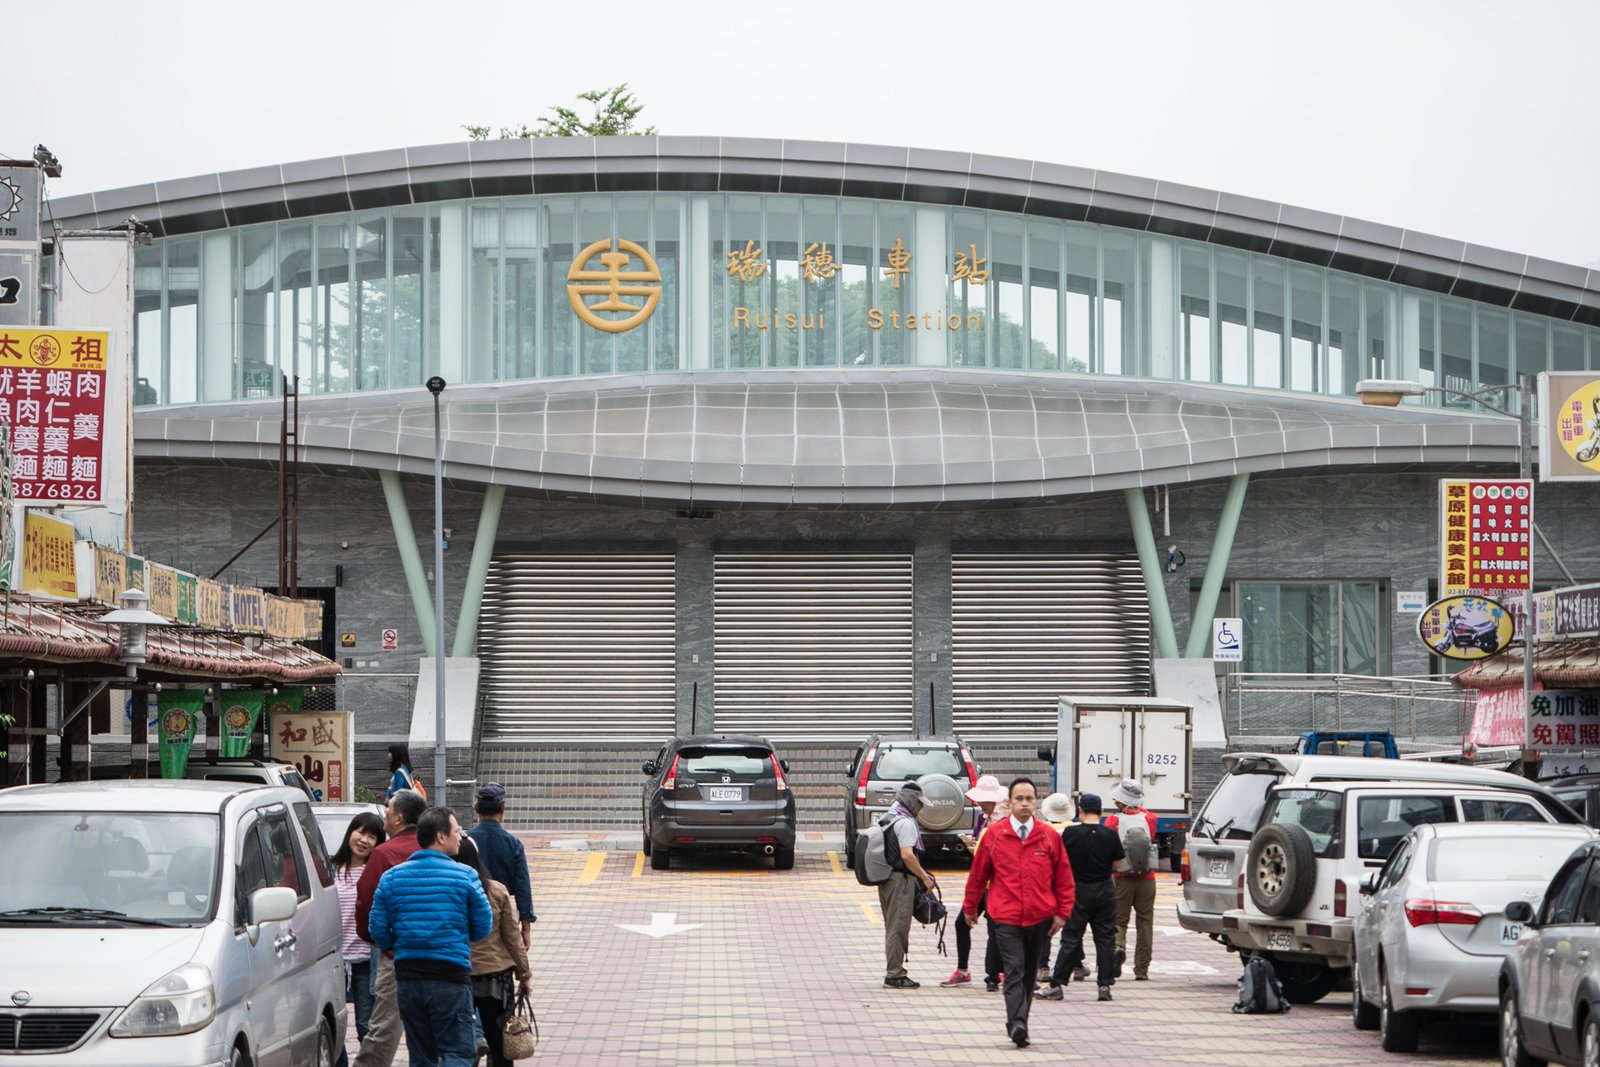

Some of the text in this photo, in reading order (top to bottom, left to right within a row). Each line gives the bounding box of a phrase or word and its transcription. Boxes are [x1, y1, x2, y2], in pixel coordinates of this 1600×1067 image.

[726, 238, 990, 289] 瑞穗車站
[734, 307, 982, 331] Ruisui Station
[1562, 418, 1573, 441] 出租
[1572, 400, 1584, 436] 電單車
[1448, 485, 1466, 585] 草原健康美食館
[233, 592, 263, 626] HOTEL
[1531, 695, 1599, 717] 免加油
[1532, 723, 1600, 746] 免駕照
[1147, 754, 1177, 765] 8252
